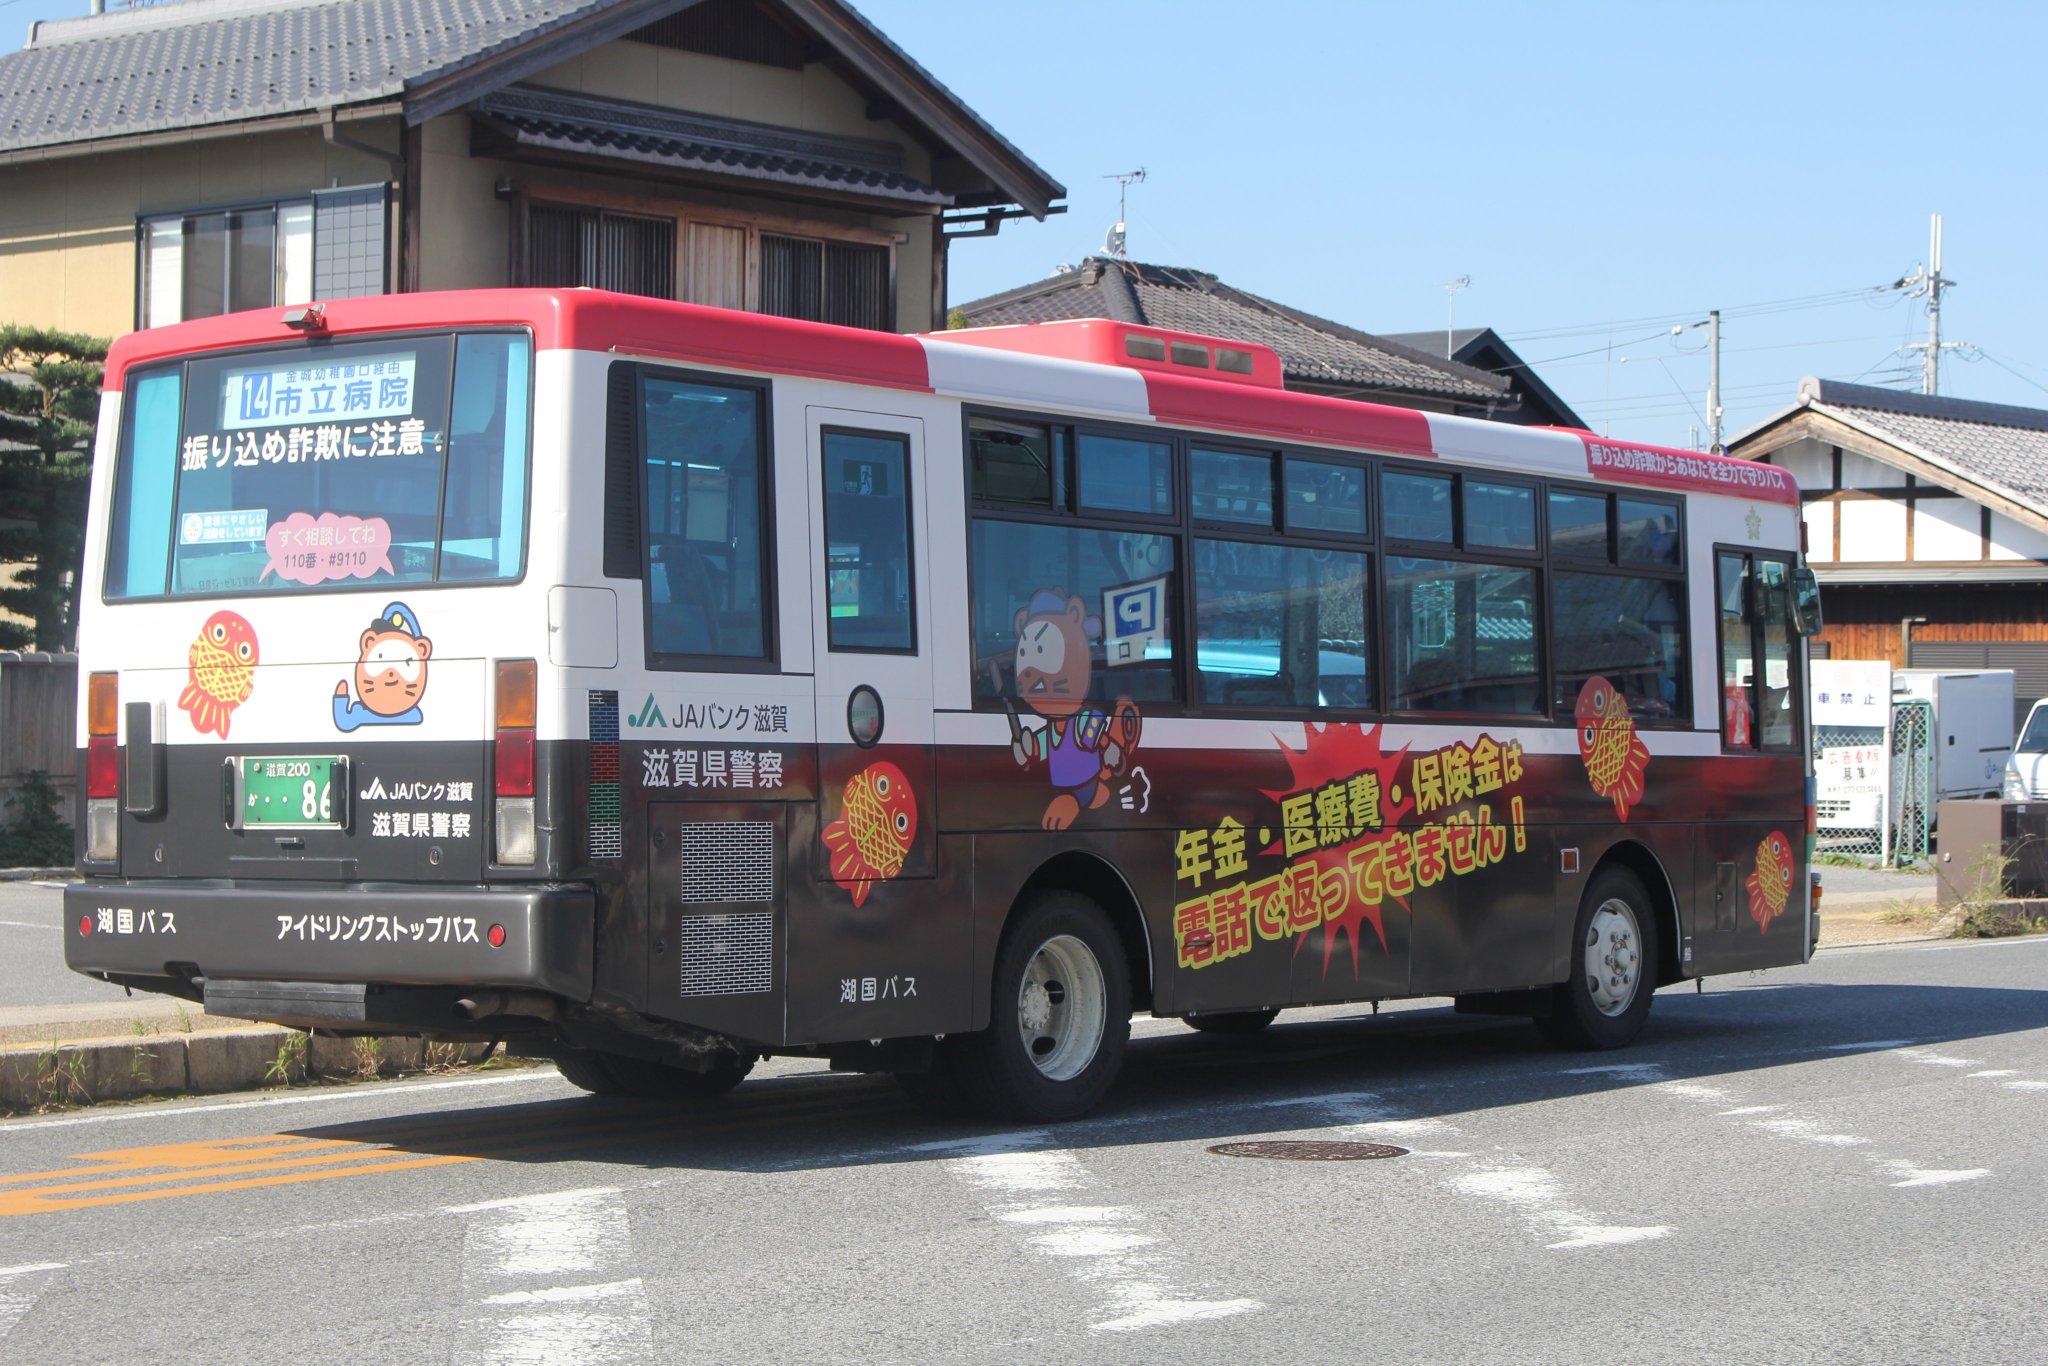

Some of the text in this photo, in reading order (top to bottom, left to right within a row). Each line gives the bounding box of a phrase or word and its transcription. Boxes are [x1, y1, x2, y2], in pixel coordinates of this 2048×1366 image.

[244, 375, 408, 417] 14 市立病院
[279, 525, 376, 548] すぐ相談してね
[642, 748, 784, 789] 滋賀県警察
[372, 812, 471, 838] 滋賀県警察
[97, 908, 177, 935] 湖国バス
[276, 914, 480, 944] アイドリングストップバス
[840, 975, 918, 1004] 湖国バス
